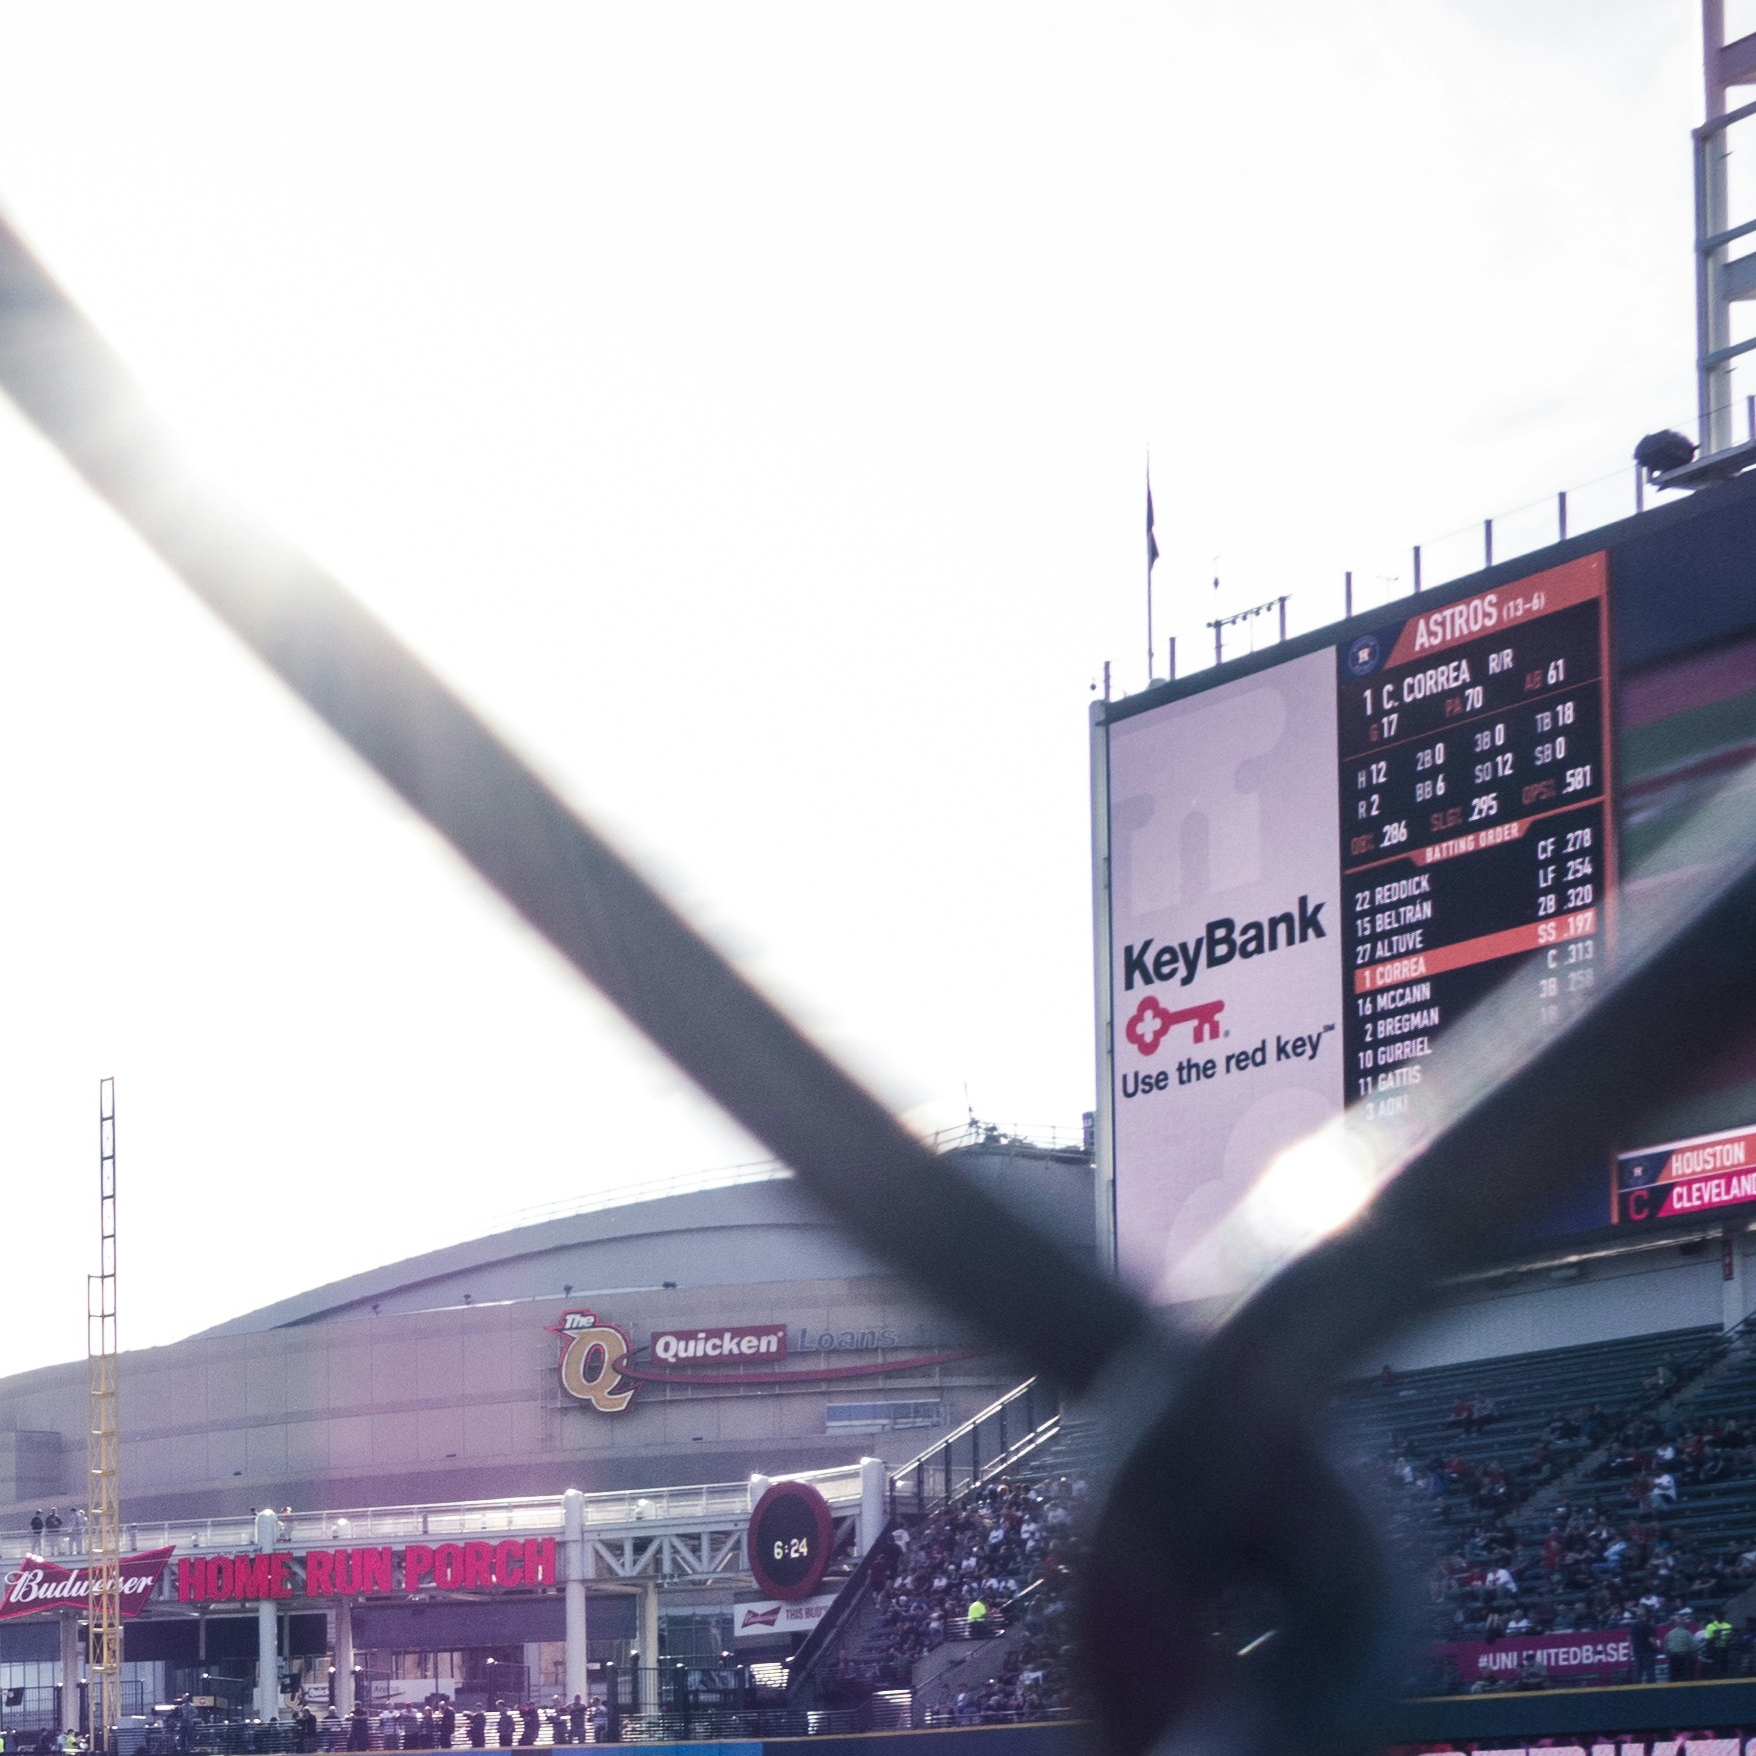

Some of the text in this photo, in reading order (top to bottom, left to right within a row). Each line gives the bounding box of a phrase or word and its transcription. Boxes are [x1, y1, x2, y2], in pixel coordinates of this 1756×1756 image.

[1414, 594, 1497, 652] ASTROS
[1363, 649, 1513, 716] 1 C. CORREA R/R
[1381, 713, 1399, 738] 17
[1465, 686, 1483, 712] 70
[1547, 659, 1565, 685] 61
[1357, 701, 1575, 789] H 12 2B 0 3B 0 TB 18
[1358, 736, 1566, 819] R 2 BB 6 SO 12 SB 0
[1380, 820, 1408, 848] .286
[1468, 793, 1498, 822] .295
[1561, 765, 1592, 794] .581
[1355, 827, 1592, 912] 22 REDDICK CF .278
[1425, 822, 1519, 863] BATTING ORDER
[1356, 856, 1593, 937] 15 BELTRÁN LF .254
[1356, 884, 1593, 964] 27 ALTUVE 2B .320
[1124, 894, 1327, 992] KeyBank
[1364, 912, 1594, 988] 1 CORREA SS .197
[1358, 997, 1372, 1017] 16
[1376, 982, 1431, 1014] MCCANN
[1365, 1024, 1374, 1043] 2
[1376, 1007, 1439, 1040] BREGMAN
[1122, 1070, 1169, 1099] Use
[1176, 1058, 1217, 1086] the
[1225, 1039, 1267, 1074] red
[1358, 1050, 1373, 1070] 10
[1377, 1036, 1433, 1066] GURRIEL
[1359, 1065, 1422, 1097] 11 GATTIS
[1672, 1141, 1746, 1177] HOUSTON
[564, 1312, 596, 1329] The
[655, 1331, 779, 1363] Quicken
[798, 1328, 899, 1353] Loans
[561, 1327, 637, 1412] Q
[178, 1536, 556, 1603] HOME RUN PORCH
[773, 1537, 808, 1560] 6:24
[4, 1568, 154, 1603] Budweiser
[786, 1606, 804, 1621] THIS
